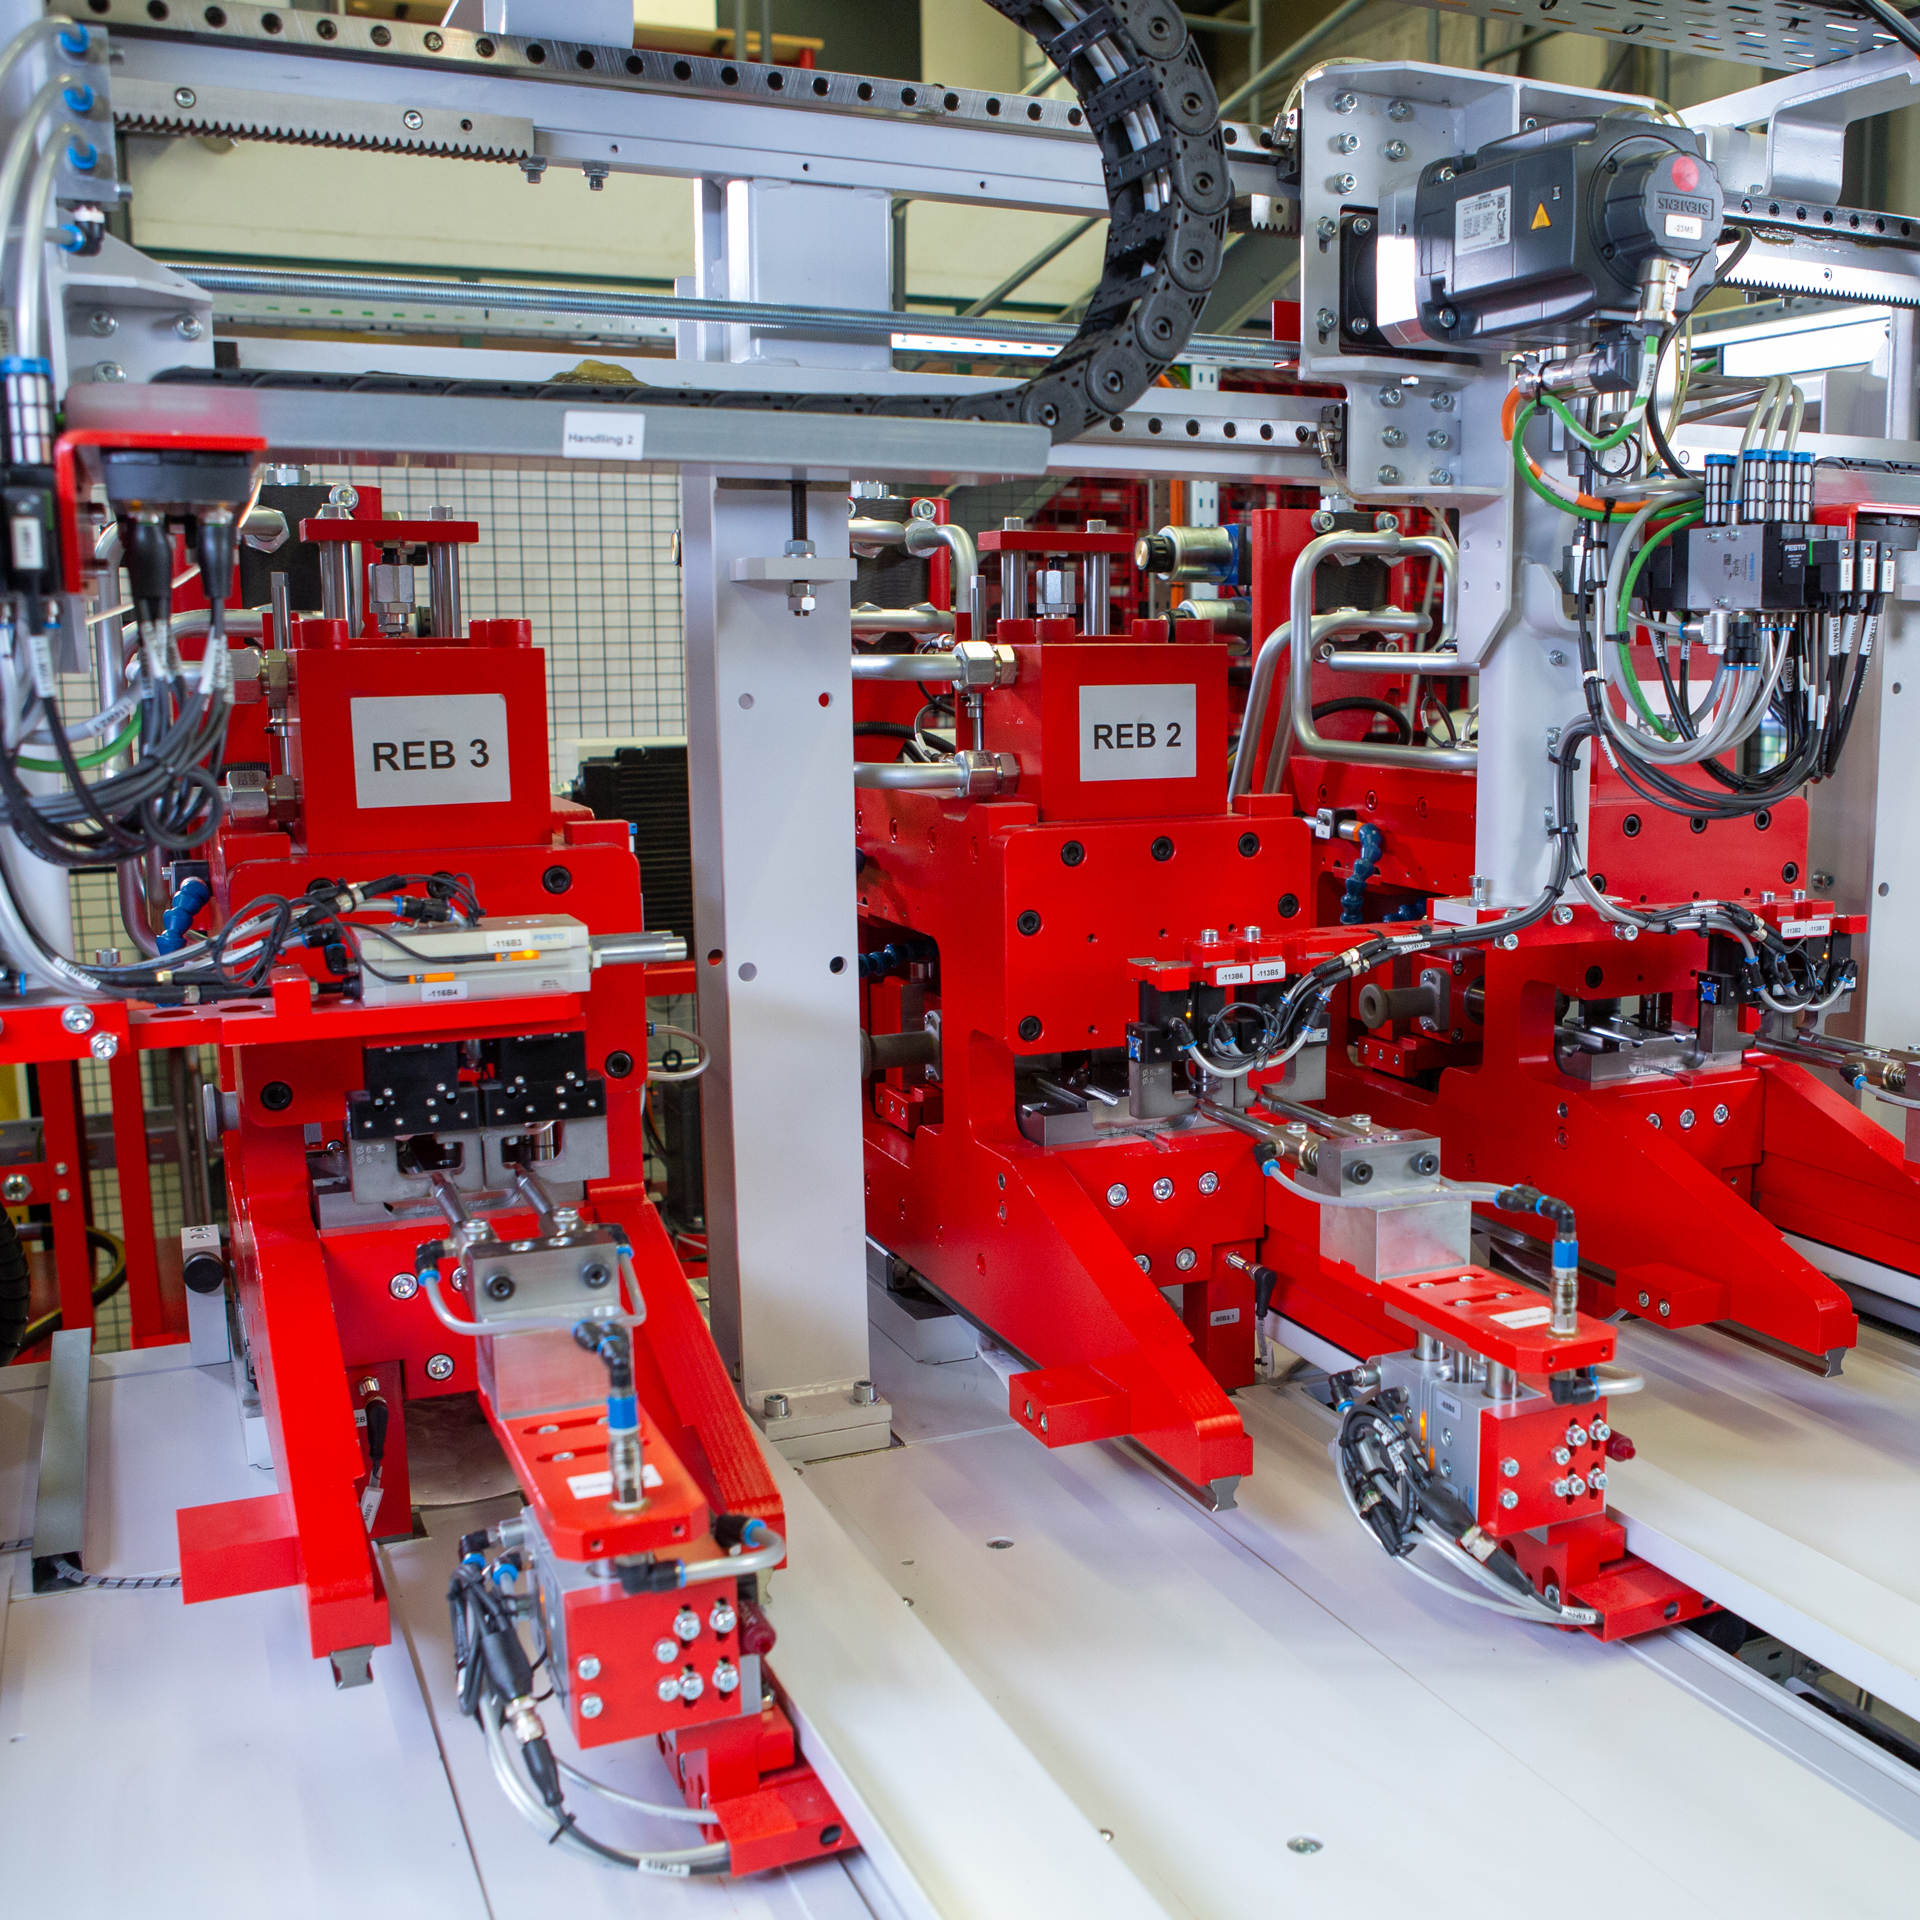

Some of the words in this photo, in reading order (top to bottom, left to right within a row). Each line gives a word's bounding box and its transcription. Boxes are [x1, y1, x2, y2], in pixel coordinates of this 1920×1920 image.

[1657, 197, 1710, 215] SIEMENS
[568, 434, 623, 447] Handling
[627, 434, 634, 445] 2
[1785, 543, 1806, 552] FESTO
[1093, 722, 1157, 750] REB
[1166, 721, 1182, 748] 2
[372, 739, 456, 772] REB
[469, 738, 490, 768] 3
[1784, 927, 1802, 935] -113B2
[1808, 924, 1826, 932] -113B1
[493, 939, 522, 948] -116B3
[1221, 972, 1244, 981] -113B6
[1257, 968, 1279, 977] -113B5
[428, 988, 458, 998] -116B4
